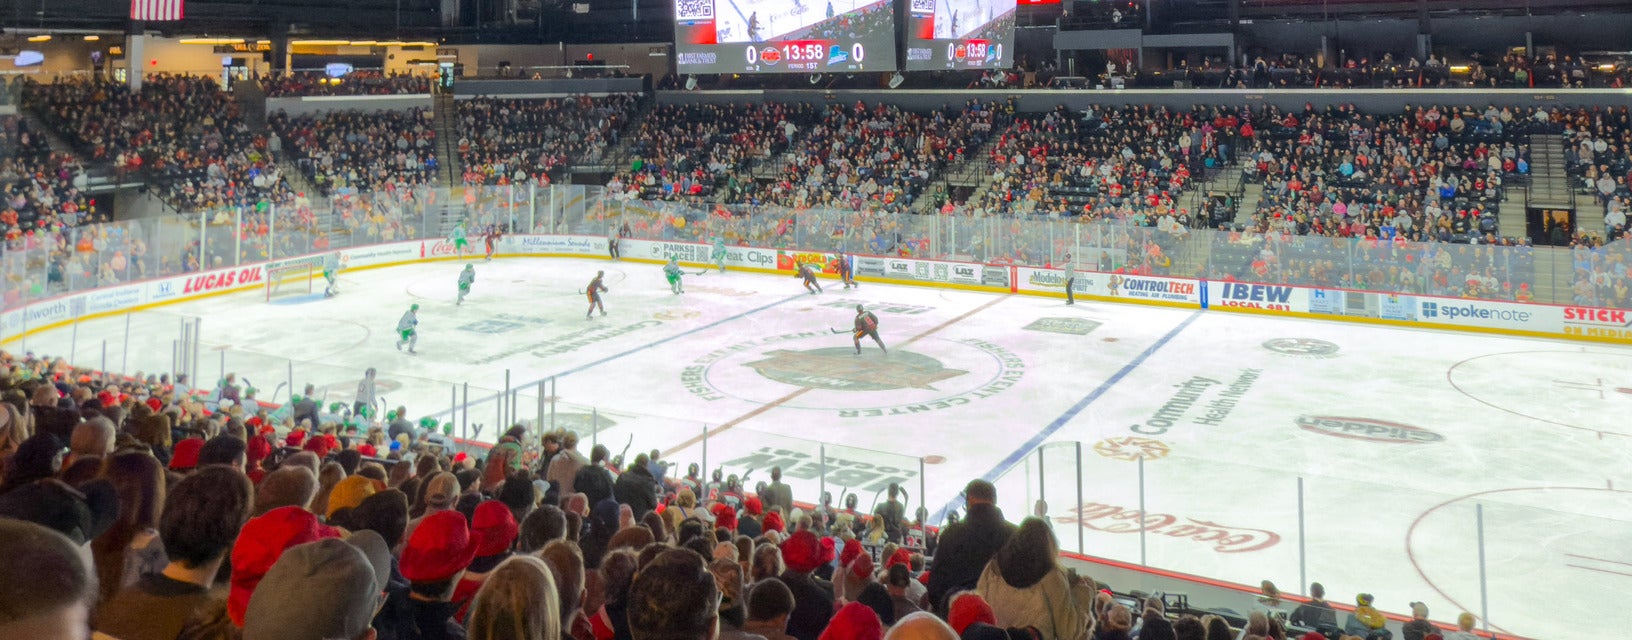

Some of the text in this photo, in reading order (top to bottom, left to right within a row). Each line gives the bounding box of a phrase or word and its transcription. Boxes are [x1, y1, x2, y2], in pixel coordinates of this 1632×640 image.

[746, 45, 757, 64] 0
[783, 44, 824, 60] 13:58
[852, 43, 864, 62] 0
[947, 42, 955, 61] 0
[966, 43, 986, 58] 13:58
[996, 42, 1003, 60] 0
[663, 243, 689, 253] PARKS
[663, 251, 690, 261] PLACE
[726, 249, 774, 266] eat Clips
[182, 266, 263, 295] LUCAS OIL
[955, 267, 974, 276] LAZ
[1123, 277, 1195, 295] CONTROLTECH
[1128, 290, 1149, 298] HEATING
[1221, 283, 1293, 303] IBEW
[1221, 300, 1262, 310] LOCAL
[1441, 303, 1530, 322] spokenote
[1563, 307, 1627, 323] STICK
[838, 396, 970, 419] CENTER
[1129, 375, 1223, 436] Community
[1192, 397, 1239, 427] Health
[1052, 501, 1282, 553] Coca-Cola
